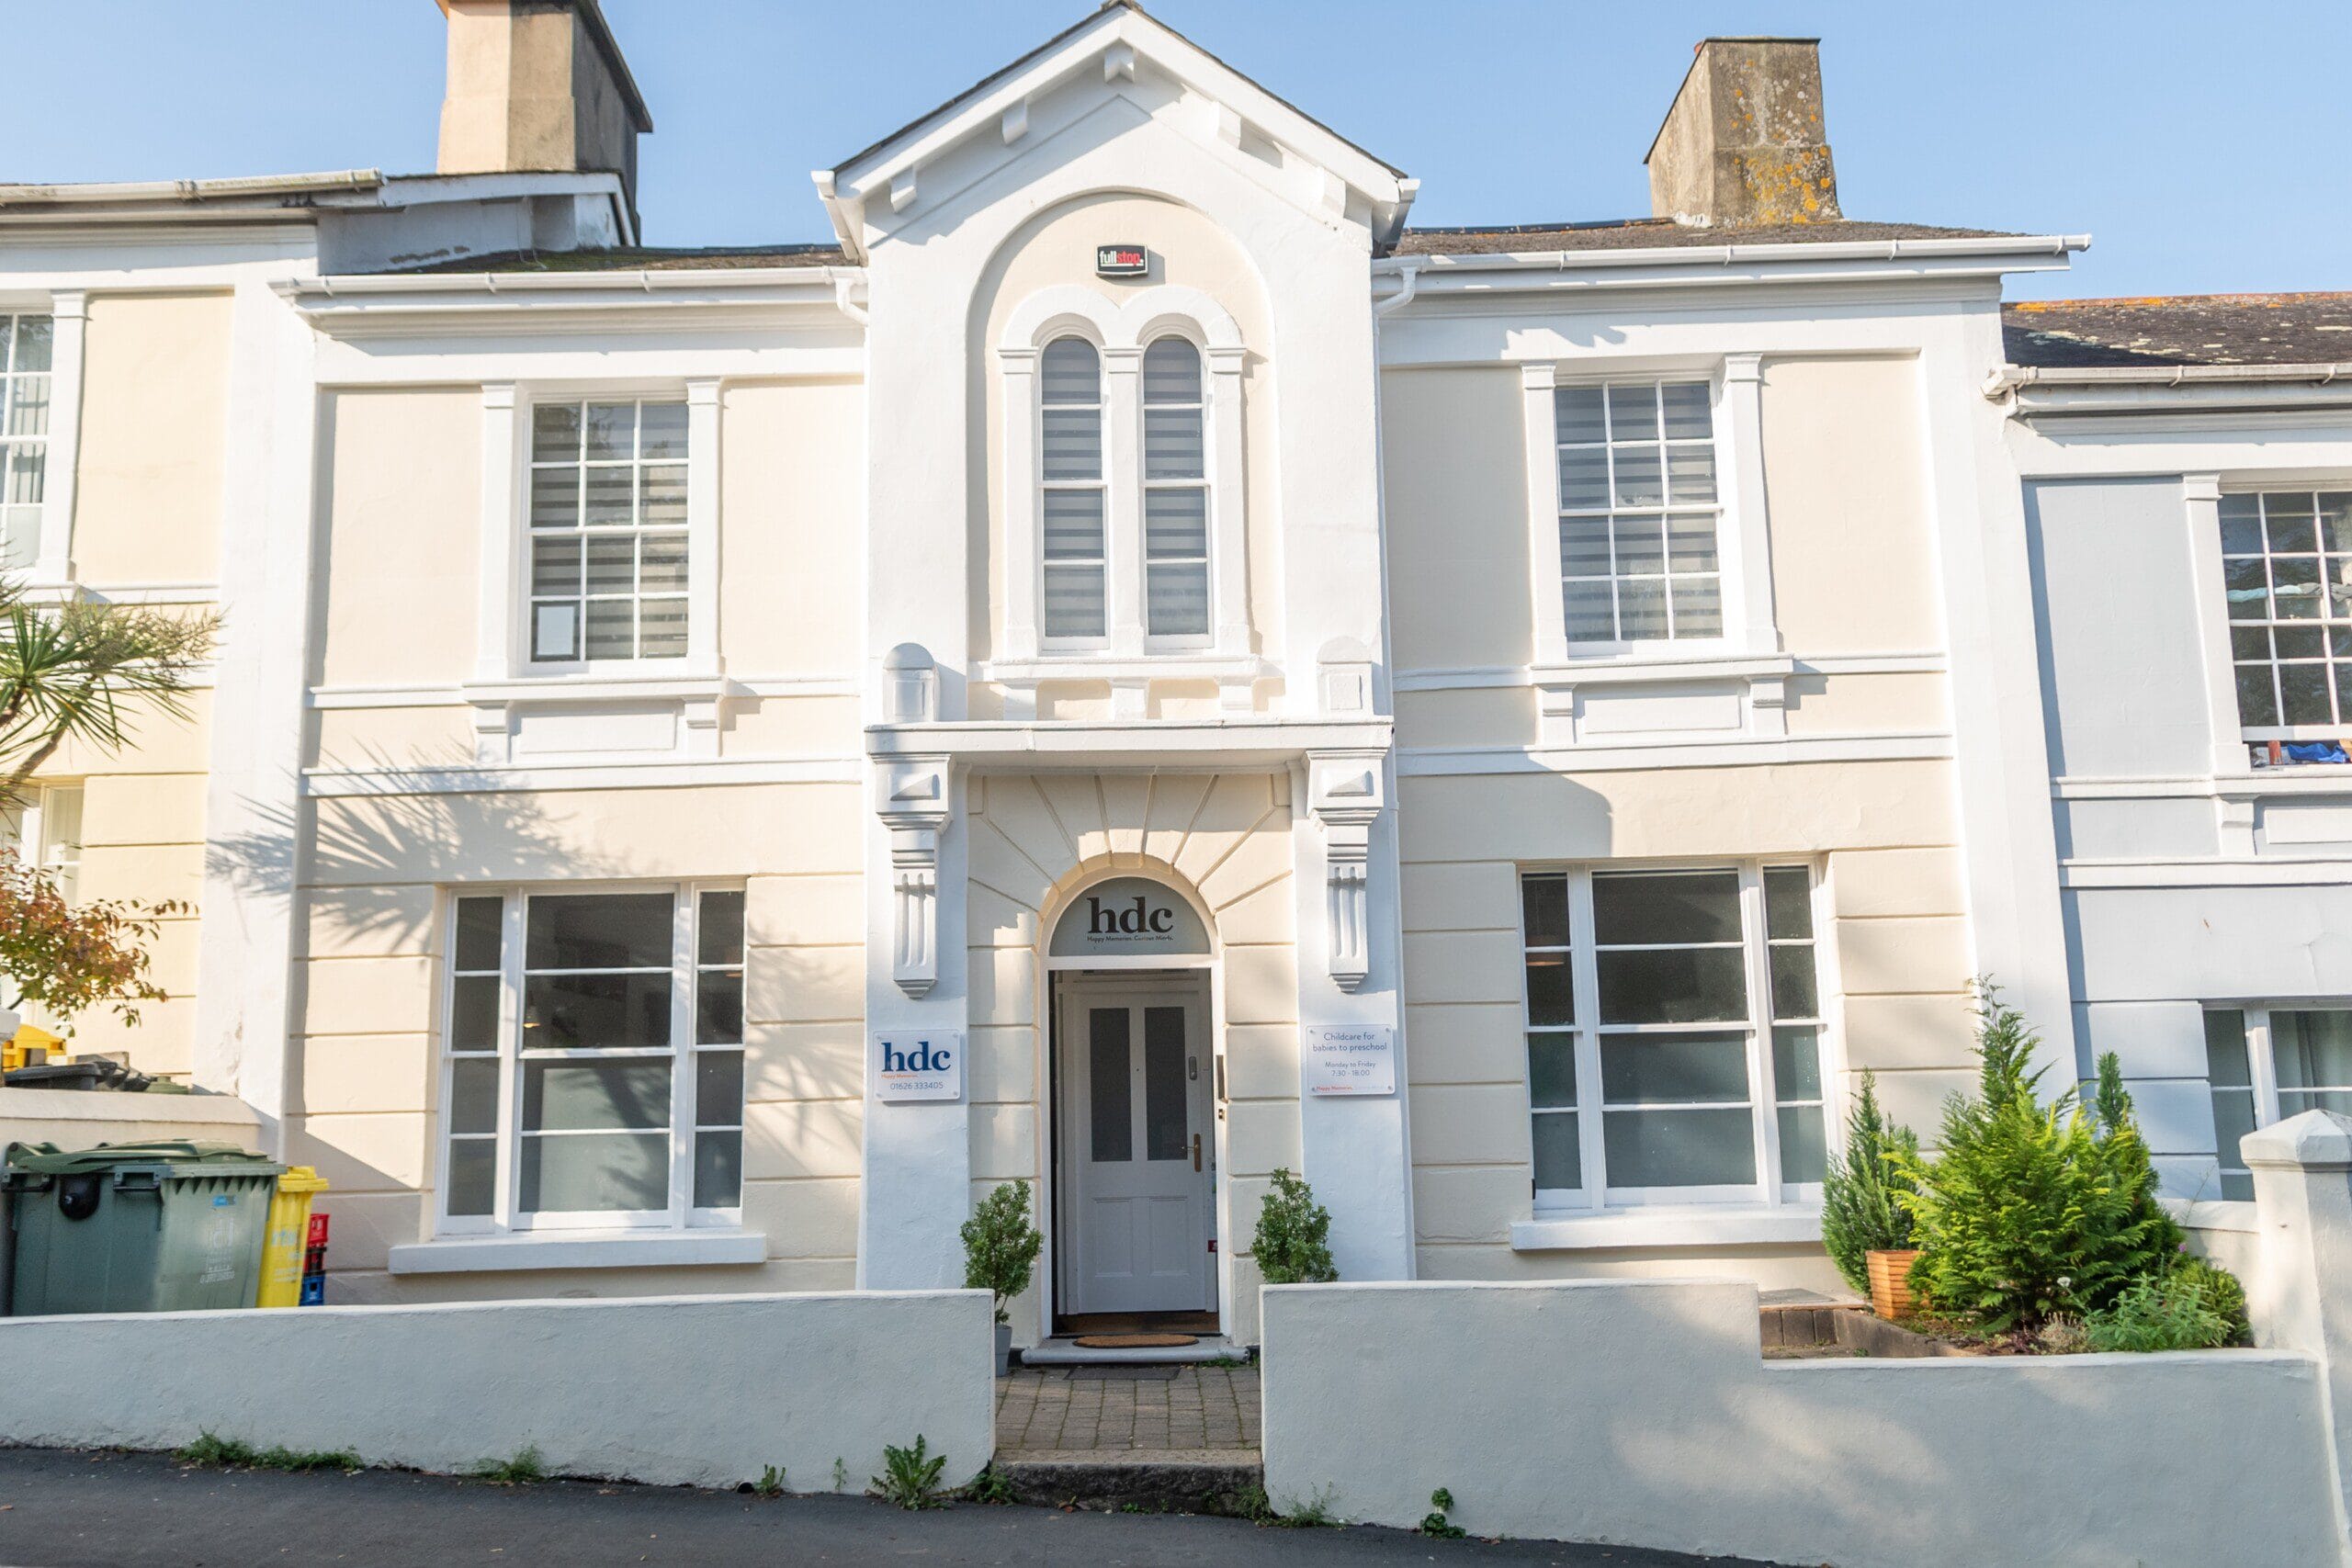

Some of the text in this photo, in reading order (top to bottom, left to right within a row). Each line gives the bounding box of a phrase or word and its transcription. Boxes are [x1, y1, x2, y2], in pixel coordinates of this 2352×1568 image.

[1086, 897, 1173, 933] hdc
[1323, 1031, 1375, 1041] Childcare for
[1312, 1042, 1387, 1054] babies to preschool
[881, 1041, 952, 1072] hdc
[1357, 1060, 1376, 1068] Friday
[889, 1081, 944, 1090] 01626 333405
